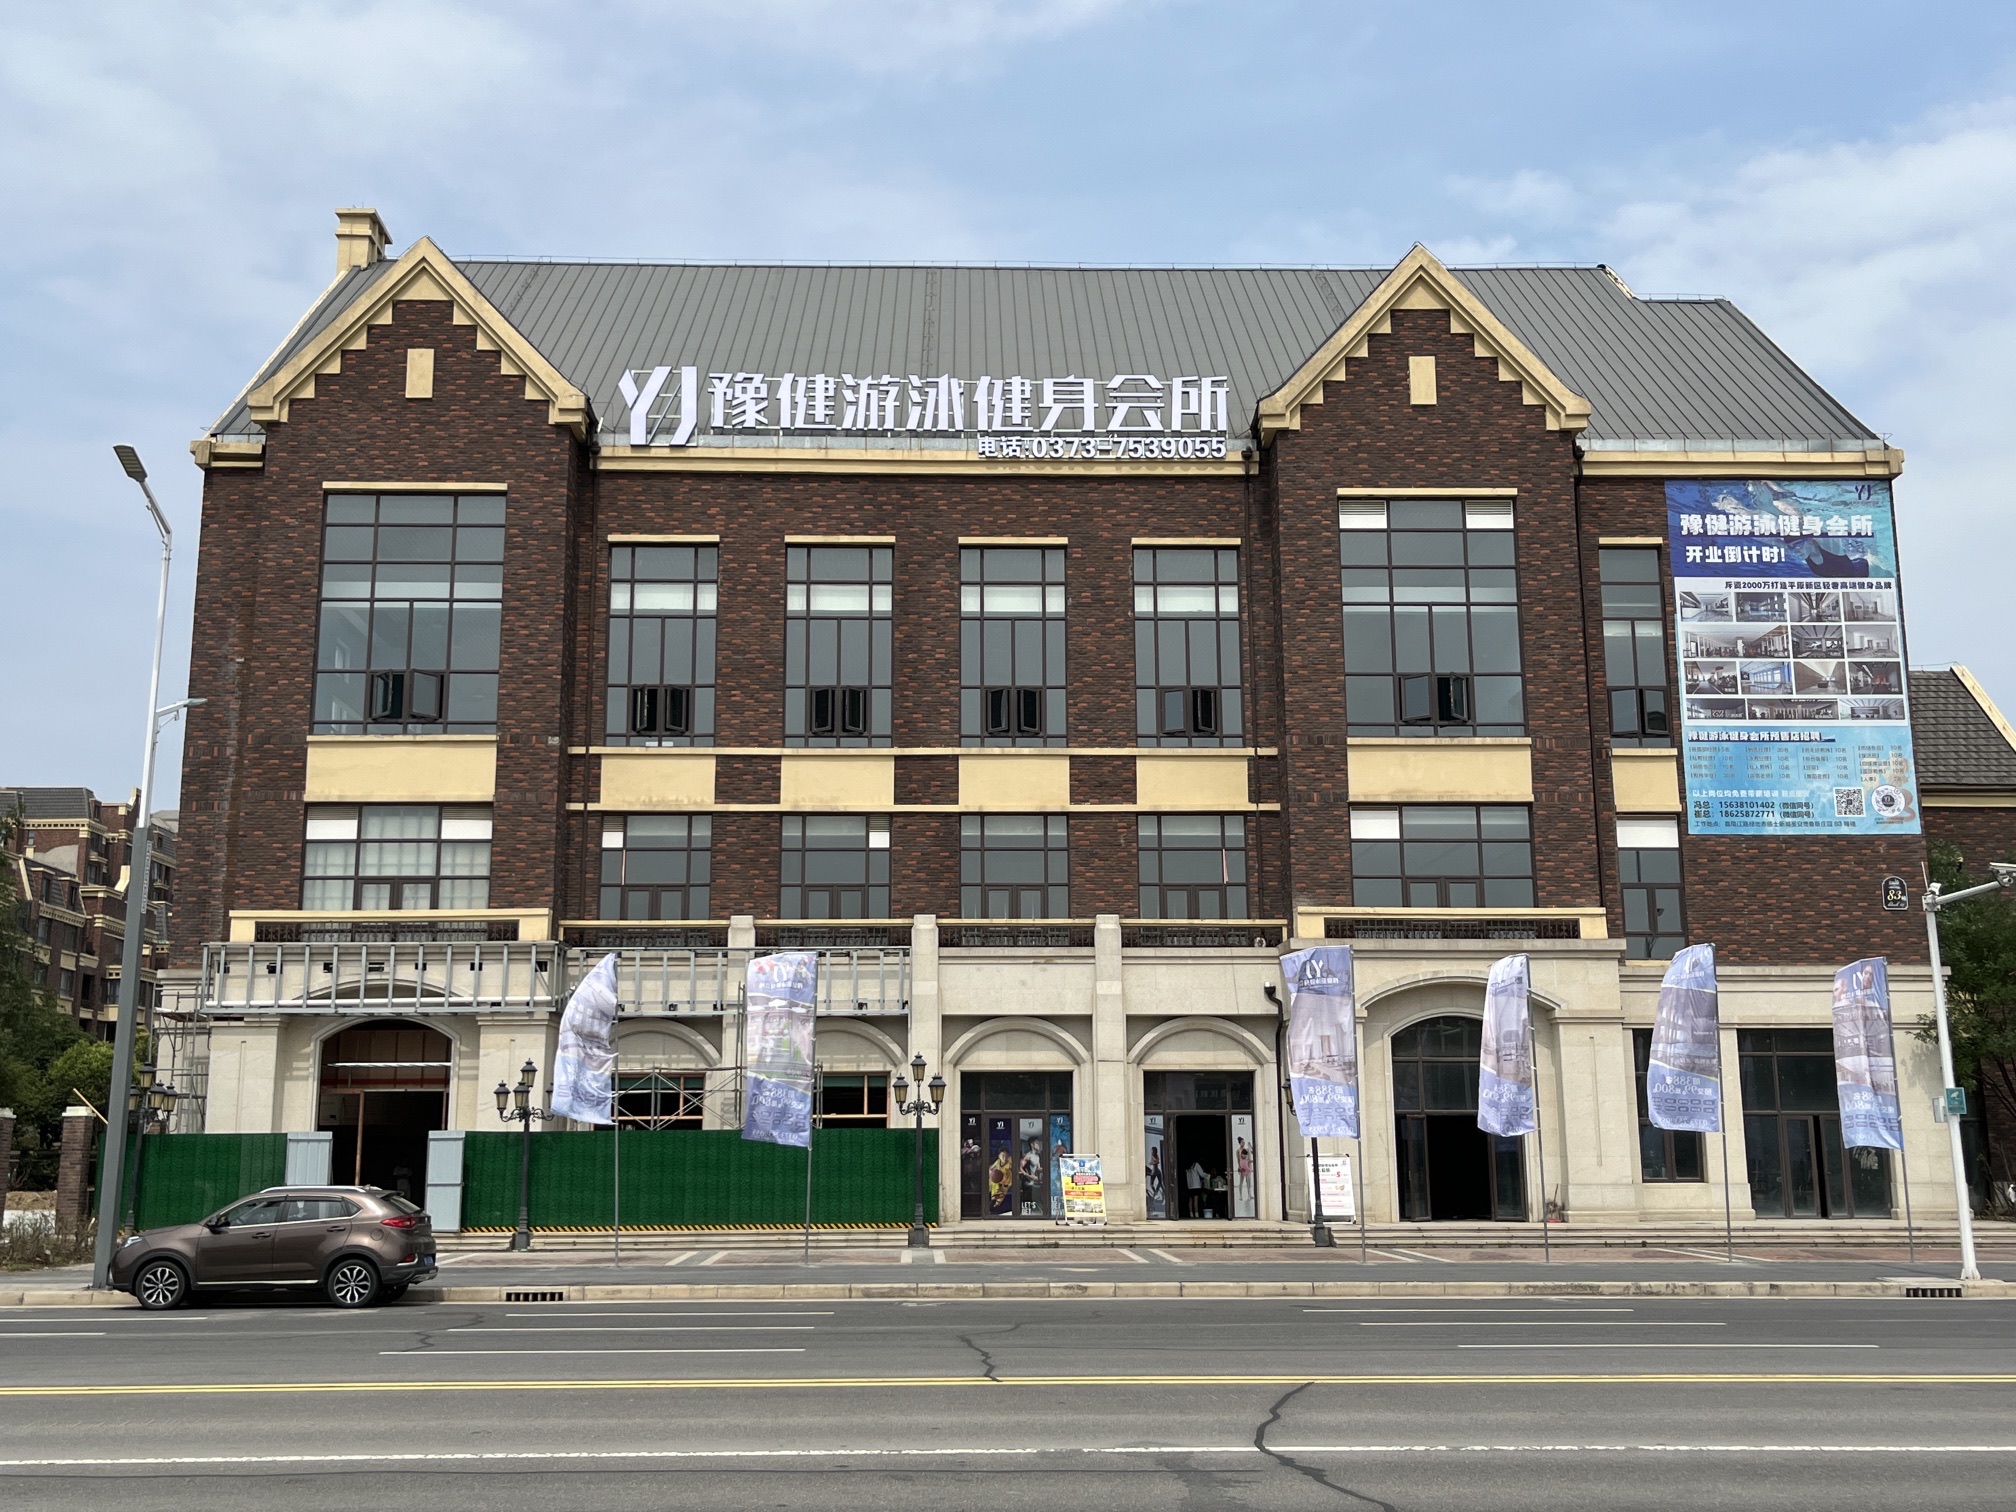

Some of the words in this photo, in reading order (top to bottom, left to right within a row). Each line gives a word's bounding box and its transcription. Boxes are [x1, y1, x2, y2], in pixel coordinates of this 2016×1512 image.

[706, 371, 1230, 432] 豫健游泳健身会所
[1680, 513, 1873, 537] 豫健游泳健身会所
[1685, 545, 1786, 563] 开业倒计时!
[1718, 801, 1775, 809] 15638101402
[1719, 810, 1776, 818] 18625872771
[1887, 889, 1902, 901] 83
